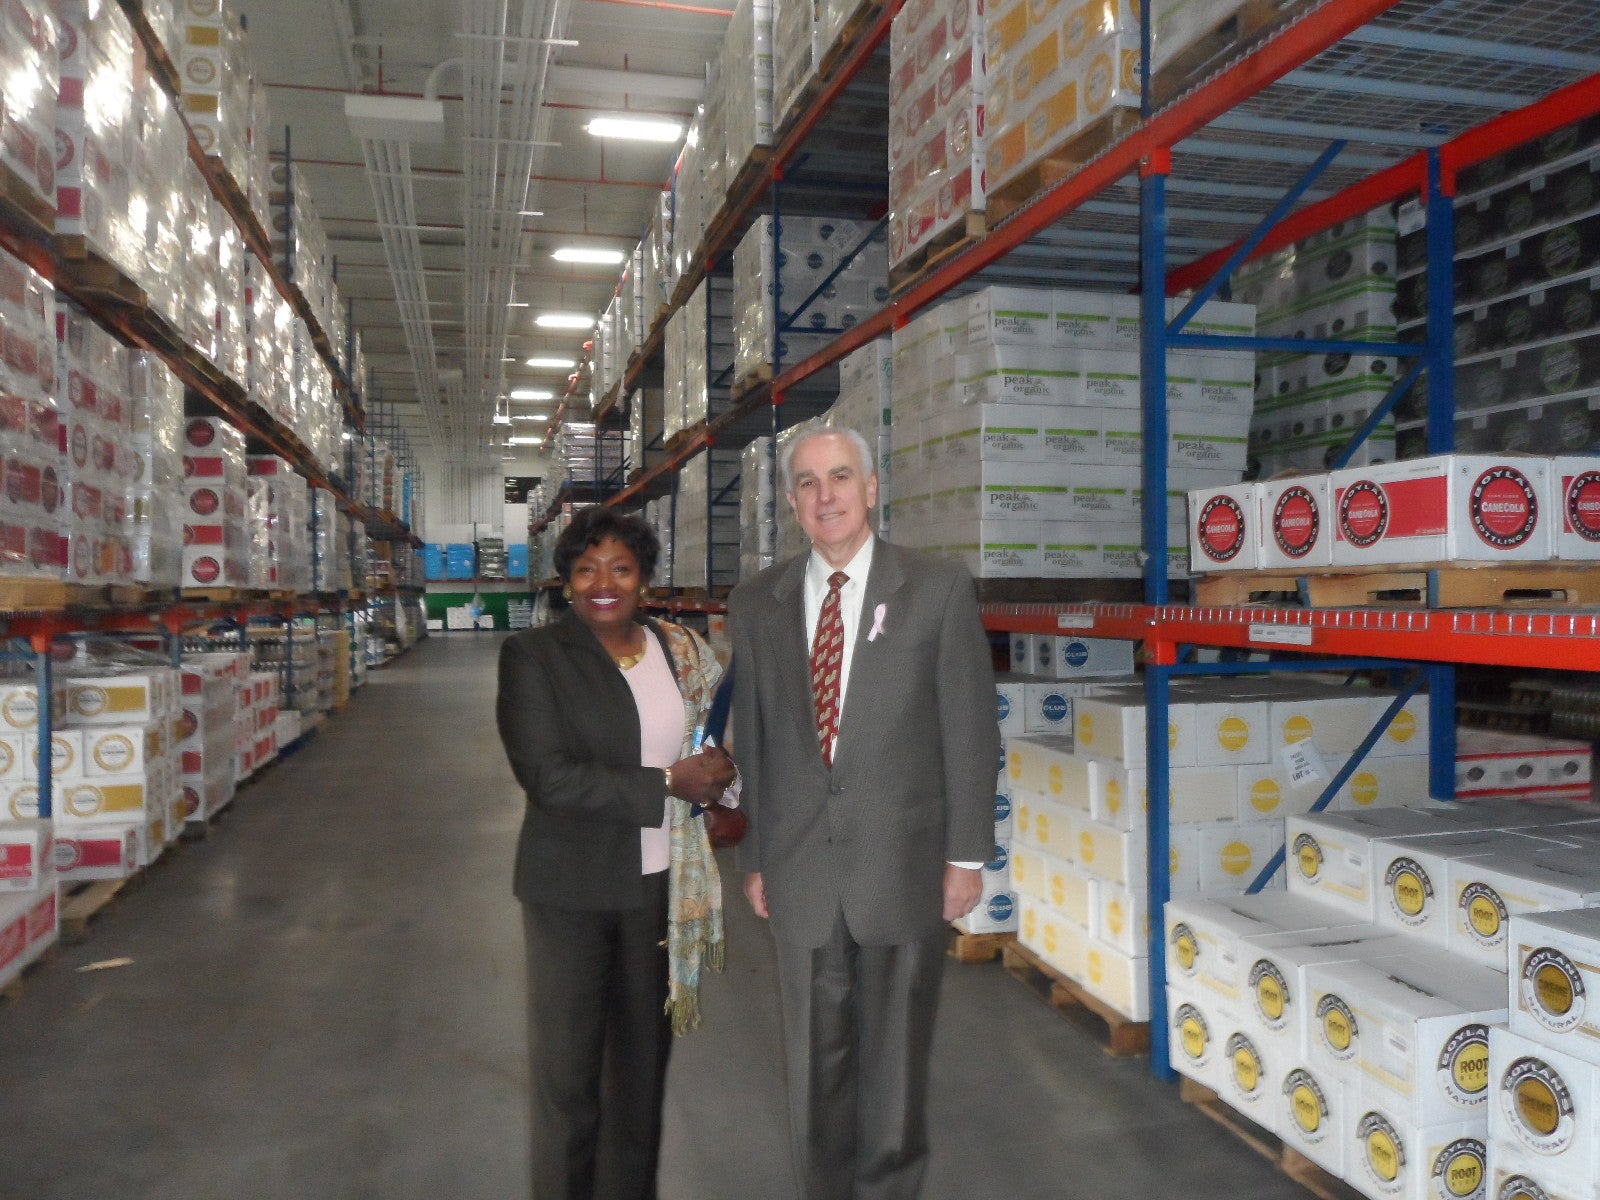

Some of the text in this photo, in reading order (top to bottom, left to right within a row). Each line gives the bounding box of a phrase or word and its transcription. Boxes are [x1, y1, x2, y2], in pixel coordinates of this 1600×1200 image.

[994, 317, 1022, 328] peak
[1056, 320, 1081, 330] peak
[1002, 325, 1035, 336] organic
[1064, 328, 1096, 337] organic
[1004, 374, 1033, 386] peak
[1086, 379, 1111, 389] peak
[1013, 384, 1049, 395] organic
[1094, 387, 1125, 396] organic
[1201, 386, 1225, 397] peak
[1208, 393, 1239, 402] organic
[983, 434, 1008, 445] peak
[1045, 436, 1070, 446] peak
[1105, 438, 1130, 448] peak
[991, 441, 1025, 451] organic
[1053, 443, 1085, 453] organic
[1177, 440, 1206, 452] peak
[1186, 450, 1221, 460] organic
[1474, 470, 1533, 498] BOYLAN
[990, 491, 1021, 503] peak
[1073, 494, 1097, 504] peak
[1343, 484, 1384, 508] BOYLAN
[999, 500, 1038, 512] organic
[1081, 502, 1112, 511] organic
[1276, 490, 1317, 515] BOYLAN
[1202, 498, 1241, 523] BOYLAN
[1475, 516, 1523, 545] BOTTLING
[984, 550, 1009, 561] peak
[1044, 551, 1069, 562] peak
[1102, 551, 1128, 562] peak
[1168, 553, 1188, 564] pea
[992, 558, 1025, 568] organic
[1052, 559, 1084, 568] organic
[1065, 650, 1087, 659] CLUB
[1043, 704, 1066, 712] CLUB
[1473, 907, 1494, 921] ROOT
[1442, 1029, 1487, 1066] BOYLA
[1451, 1166, 1477, 1180] ROOT
